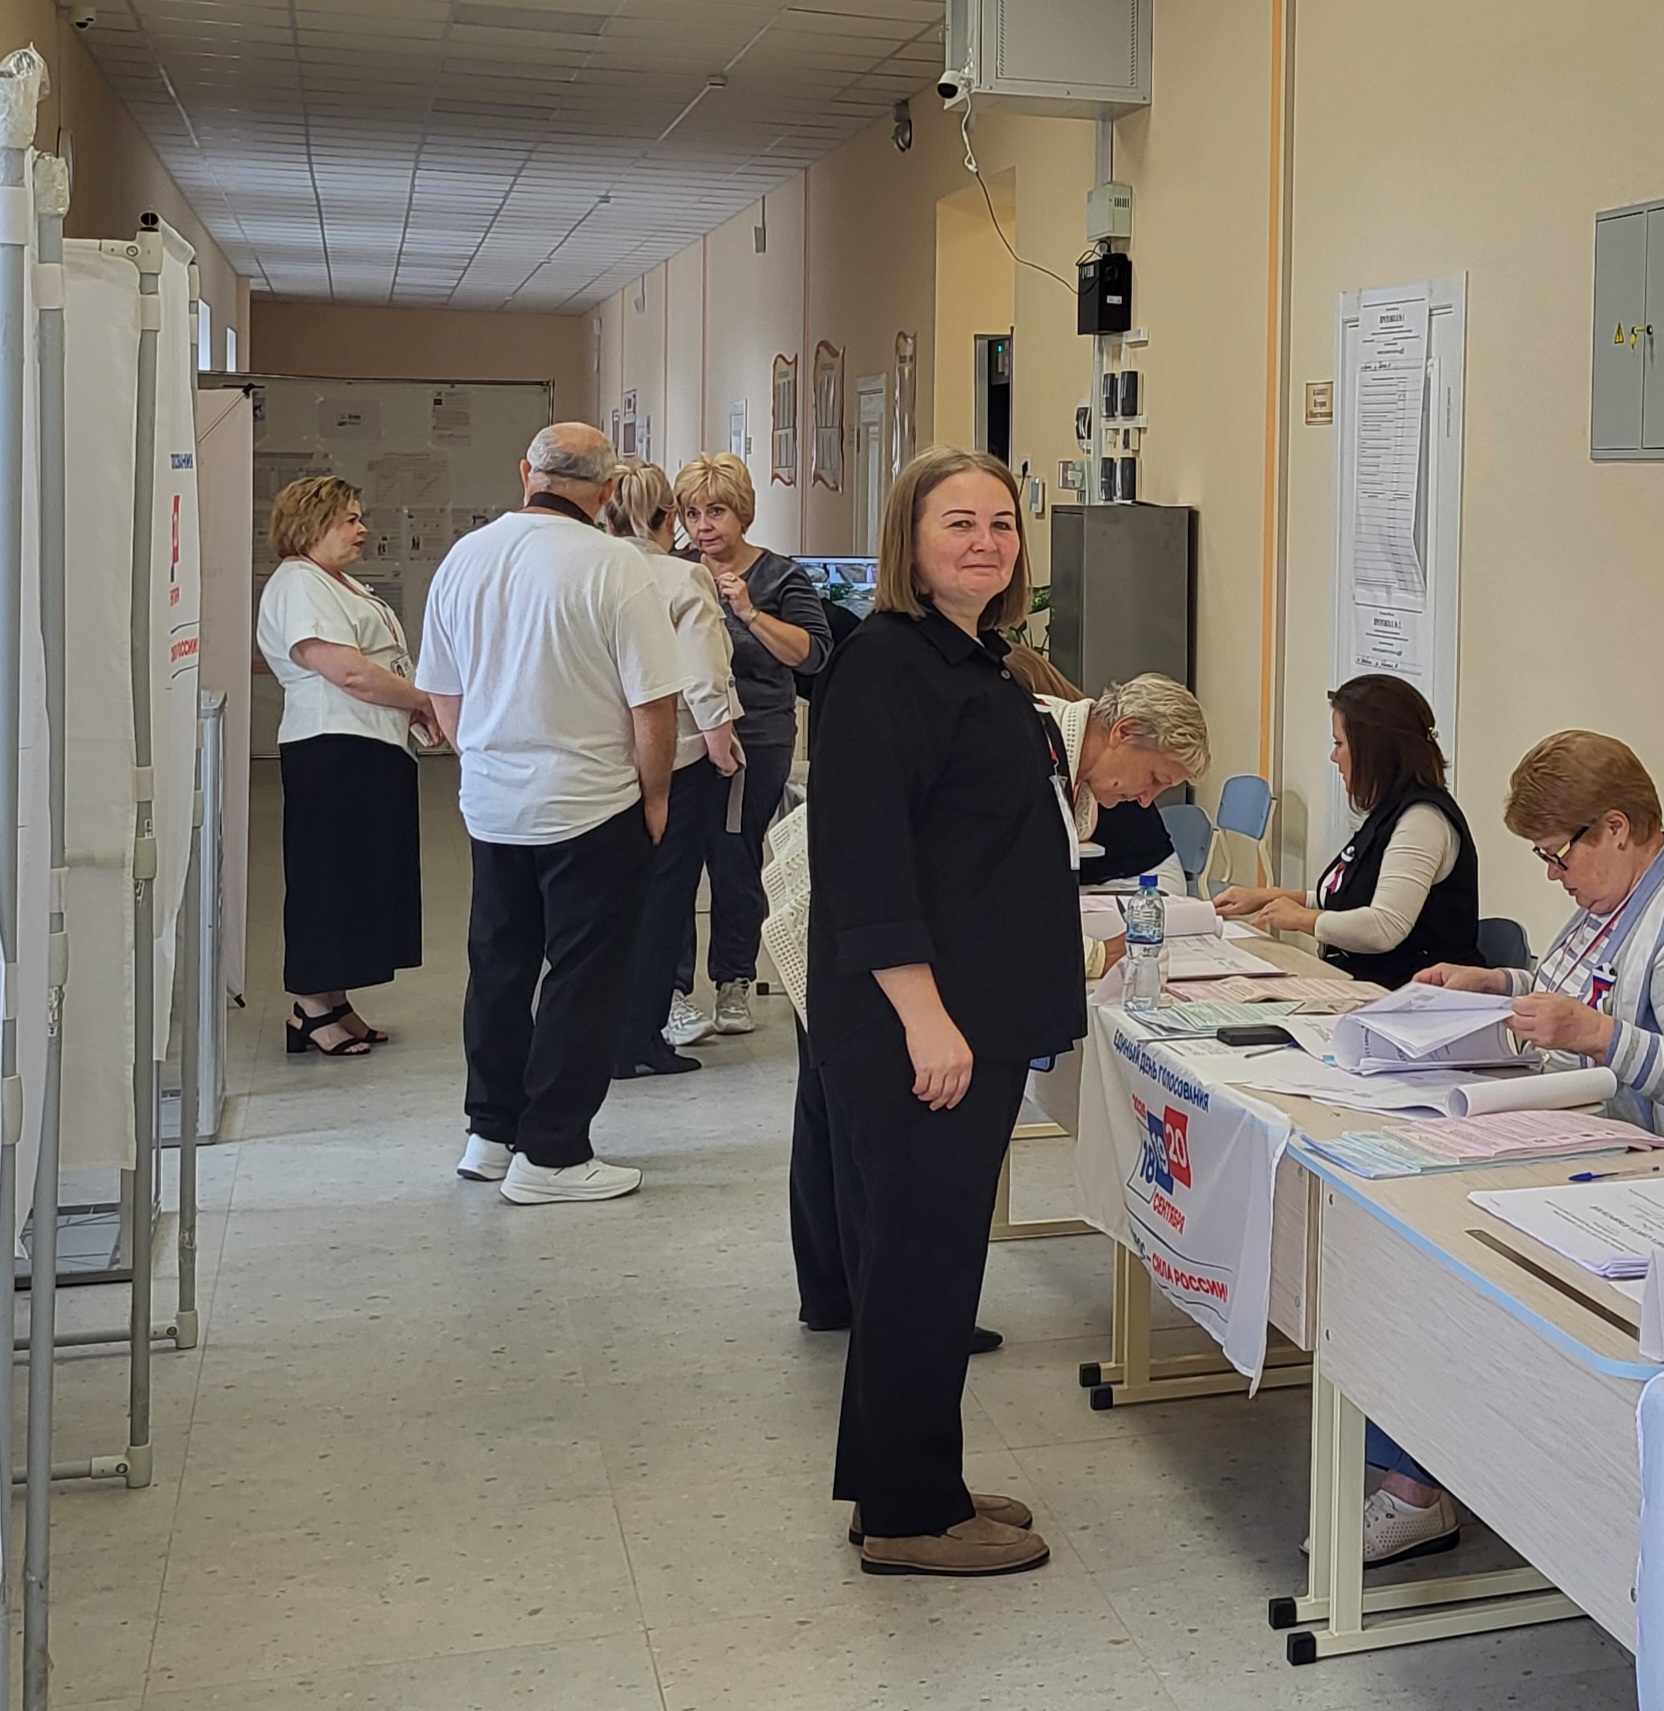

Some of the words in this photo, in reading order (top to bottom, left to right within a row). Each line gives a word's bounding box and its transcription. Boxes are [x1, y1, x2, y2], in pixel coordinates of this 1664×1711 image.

[1139, 1052, 1158, 1080] ДЕНЬ
[1140, 1140, 1155, 1184] 18
[1151, 1131, 1169, 1175] 19
[1165, 1122, 1187, 1168] 20
[1152, 1192, 1185, 1236] СЕНТЯБРЯ
[1152, 1252, 1174, 1284] СИЛА
